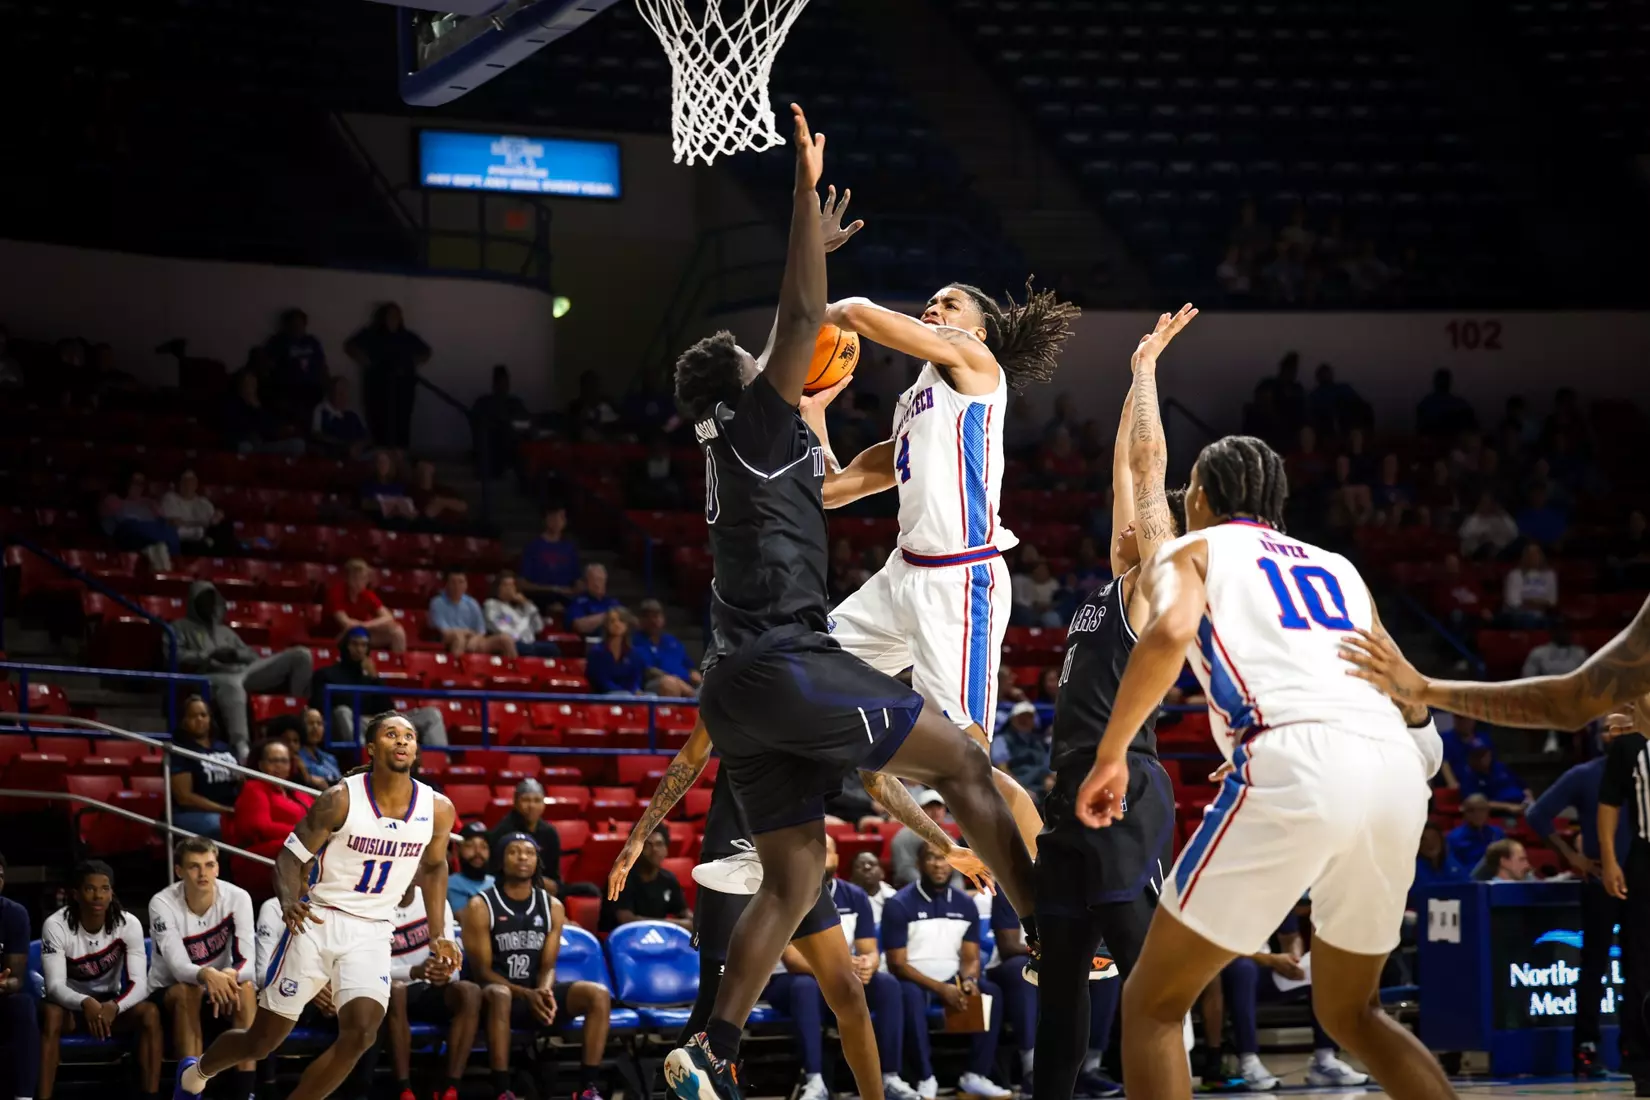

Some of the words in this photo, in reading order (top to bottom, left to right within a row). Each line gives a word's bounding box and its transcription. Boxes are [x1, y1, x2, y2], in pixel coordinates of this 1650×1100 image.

[1444, 319, 1503, 350] 102
[896, 431, 911, 484] 4
[1256, 556, 1354, 630] 10
[1066, 603, 1107, 638] ERS
[346, 834, 398, 857] LOUISIANA
[399, 842, 423, 857] TECH
[353, 859, 393, 894] 11
[495, 930, 546, 952] TIGERS
[506, 953, 531, 979] 12
[1510, 960, 1607, 987] Northe
[1611, 960, 1625, 984] L
